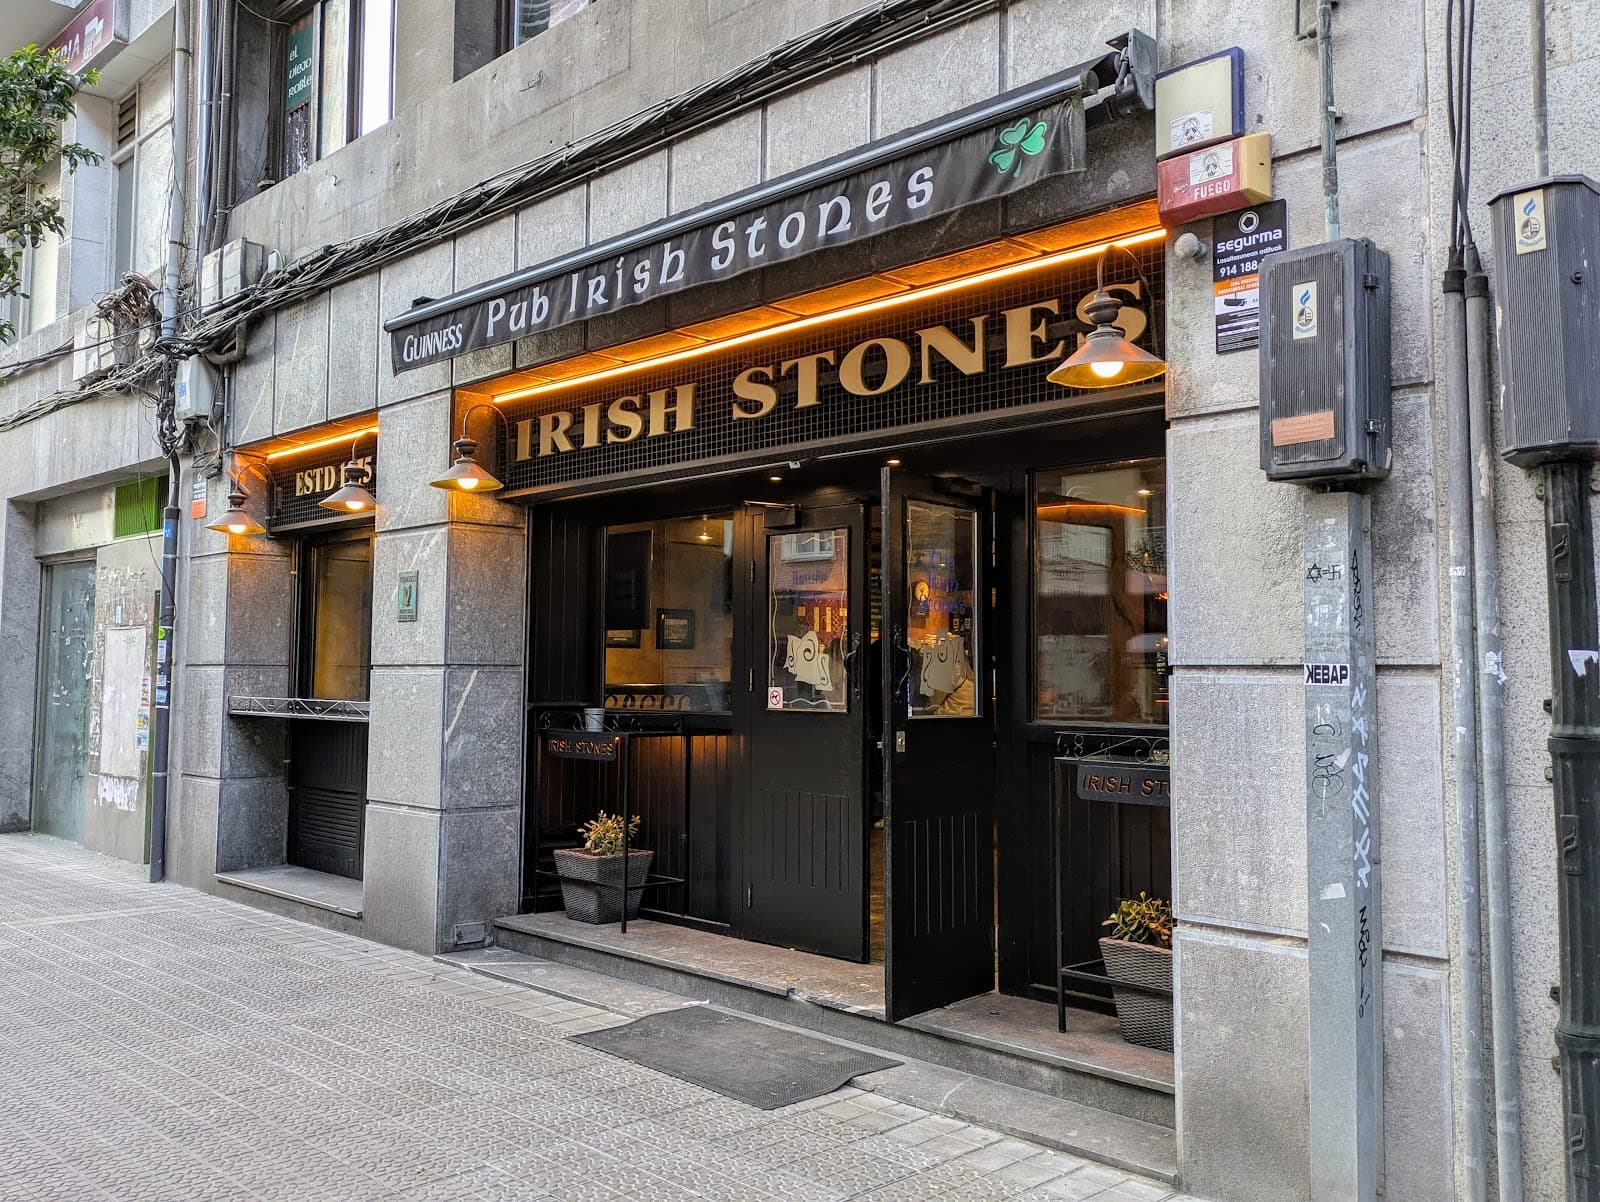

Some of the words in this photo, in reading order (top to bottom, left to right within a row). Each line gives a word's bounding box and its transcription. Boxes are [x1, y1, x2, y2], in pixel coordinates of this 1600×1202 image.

[1194, 179, 1231, 200] FUEGO
[486, 286, 549, 338] Pub
[568, 249, 685, 314] Irish
[711, 166, 935, 271] Stones
[1216, 228, 1282, 253] segurma
[1219, 264, 1237, 278] 914
[1240, 260, 1258, 273] 188
[403, 323, 463, 363] GUINNESS
[516, 383, 696, 461] IRISH
[732, 280, 1147, 420] STONES
[295, 465, 336, 497] ESTD
[1305, 664, 1348, 684] KEBAP
[548, 739, 572, 753] IRISH
[575, 741, 614, 756] STONES
[1082, 773, 1132, 794] IRISH
[1140, 778, 1170, 798] ST
